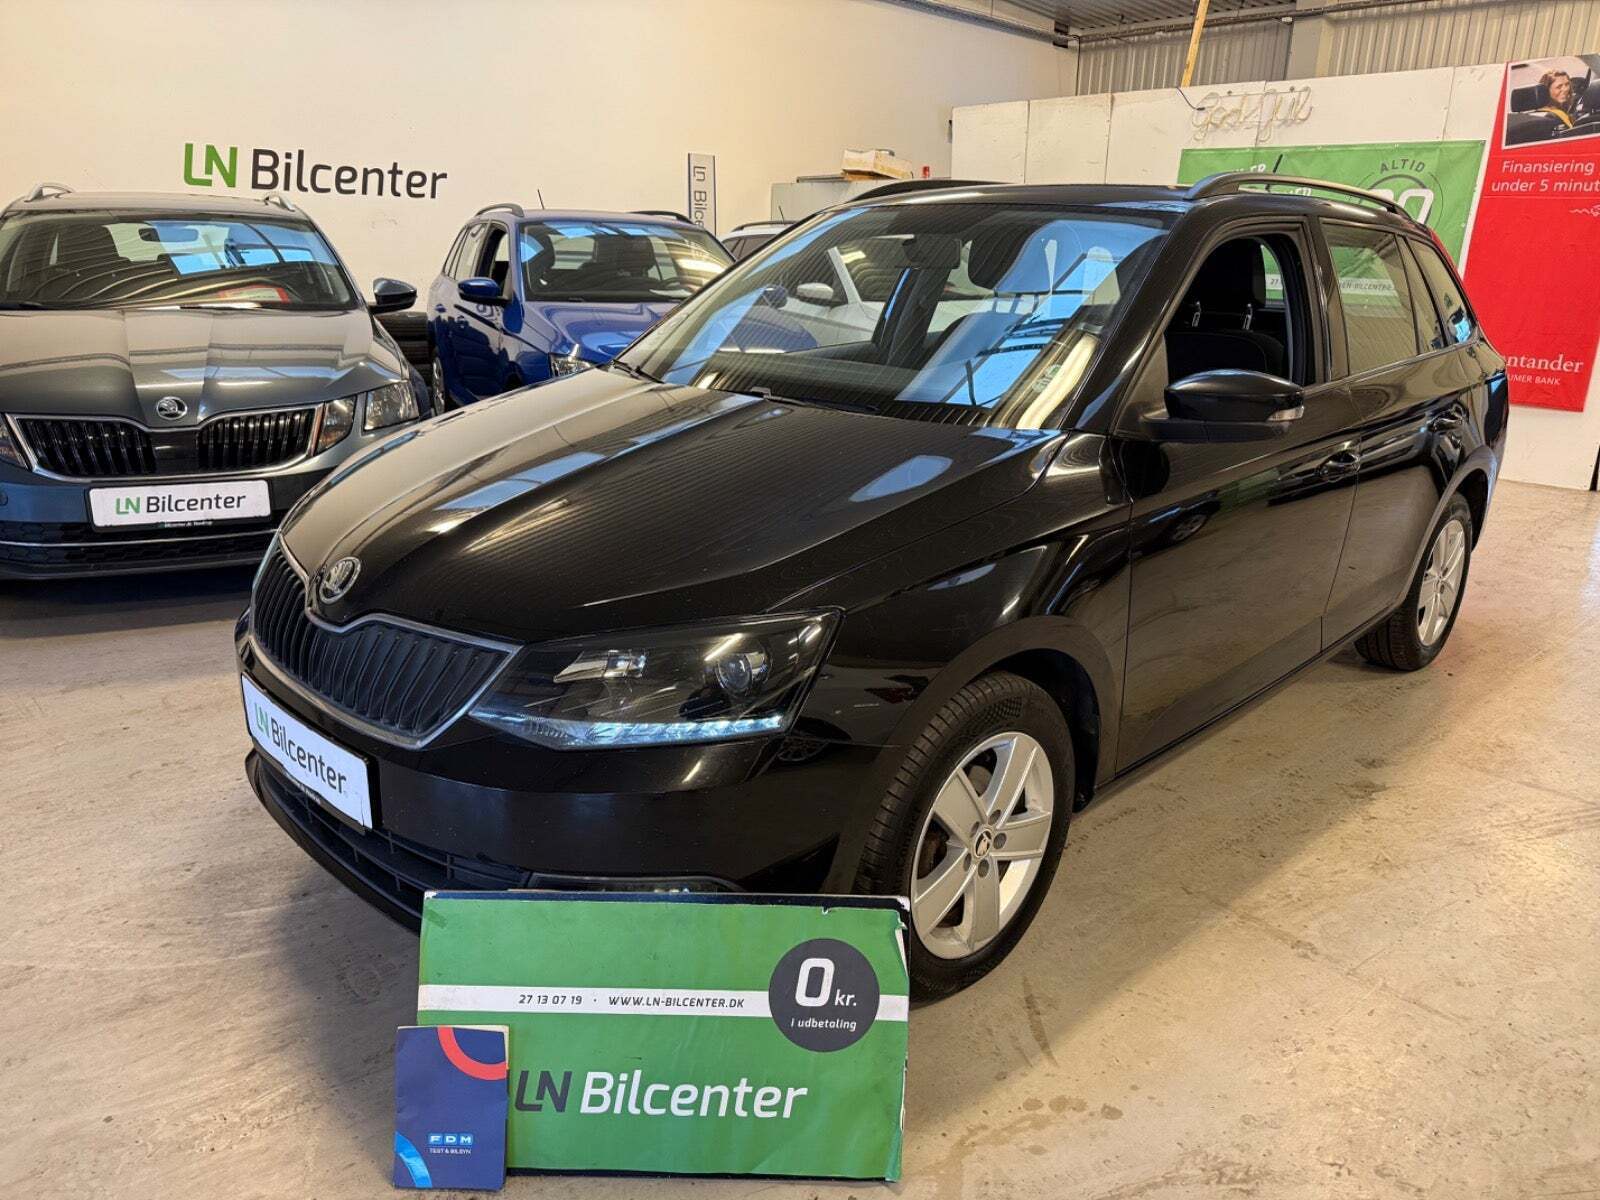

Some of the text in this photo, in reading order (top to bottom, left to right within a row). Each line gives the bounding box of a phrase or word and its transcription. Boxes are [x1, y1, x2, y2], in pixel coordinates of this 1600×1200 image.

[183, 142, 448, 199] LN Bilcenter
[1380, 158, 1426, 174] ALTID
[1502, 161, 1595, 176] Finansiering
[1492, 180, 1535, 192] under
[1539, 179, 1549, 192] 5
[1506, 354, 1583, 372] ntander
[1535, 376, 1561, 385] BANK
[115, 493, 246, 515] LN Bilcenter
[254, 702, 347, 794] LN Bilcenter
[795, 957, 857, 1007] 0 kr.
[519, 994, 745, 1008] 27 13 07 19 WWW.LN-BILCENTER.DK
[797, 1017, 857, 1032] udbetaling
[514, 1069, 808, 1119] LN Bilcenter
[430, 1135, 471, 1144] FDM
